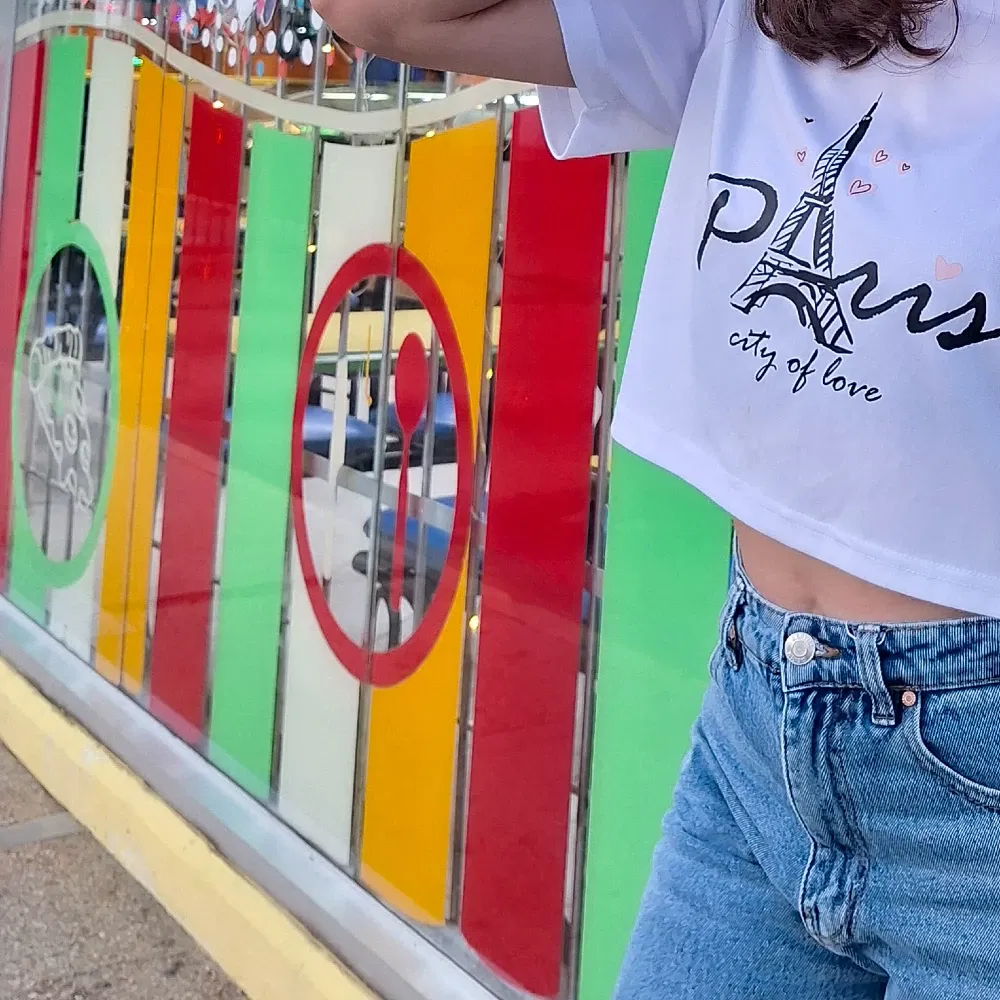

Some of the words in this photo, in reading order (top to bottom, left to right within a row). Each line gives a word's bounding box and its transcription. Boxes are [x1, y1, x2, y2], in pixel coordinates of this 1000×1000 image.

[729, 329, 777, 381] city
[787, 349, 816, 394] of
[822, 357, 882, 402] love
